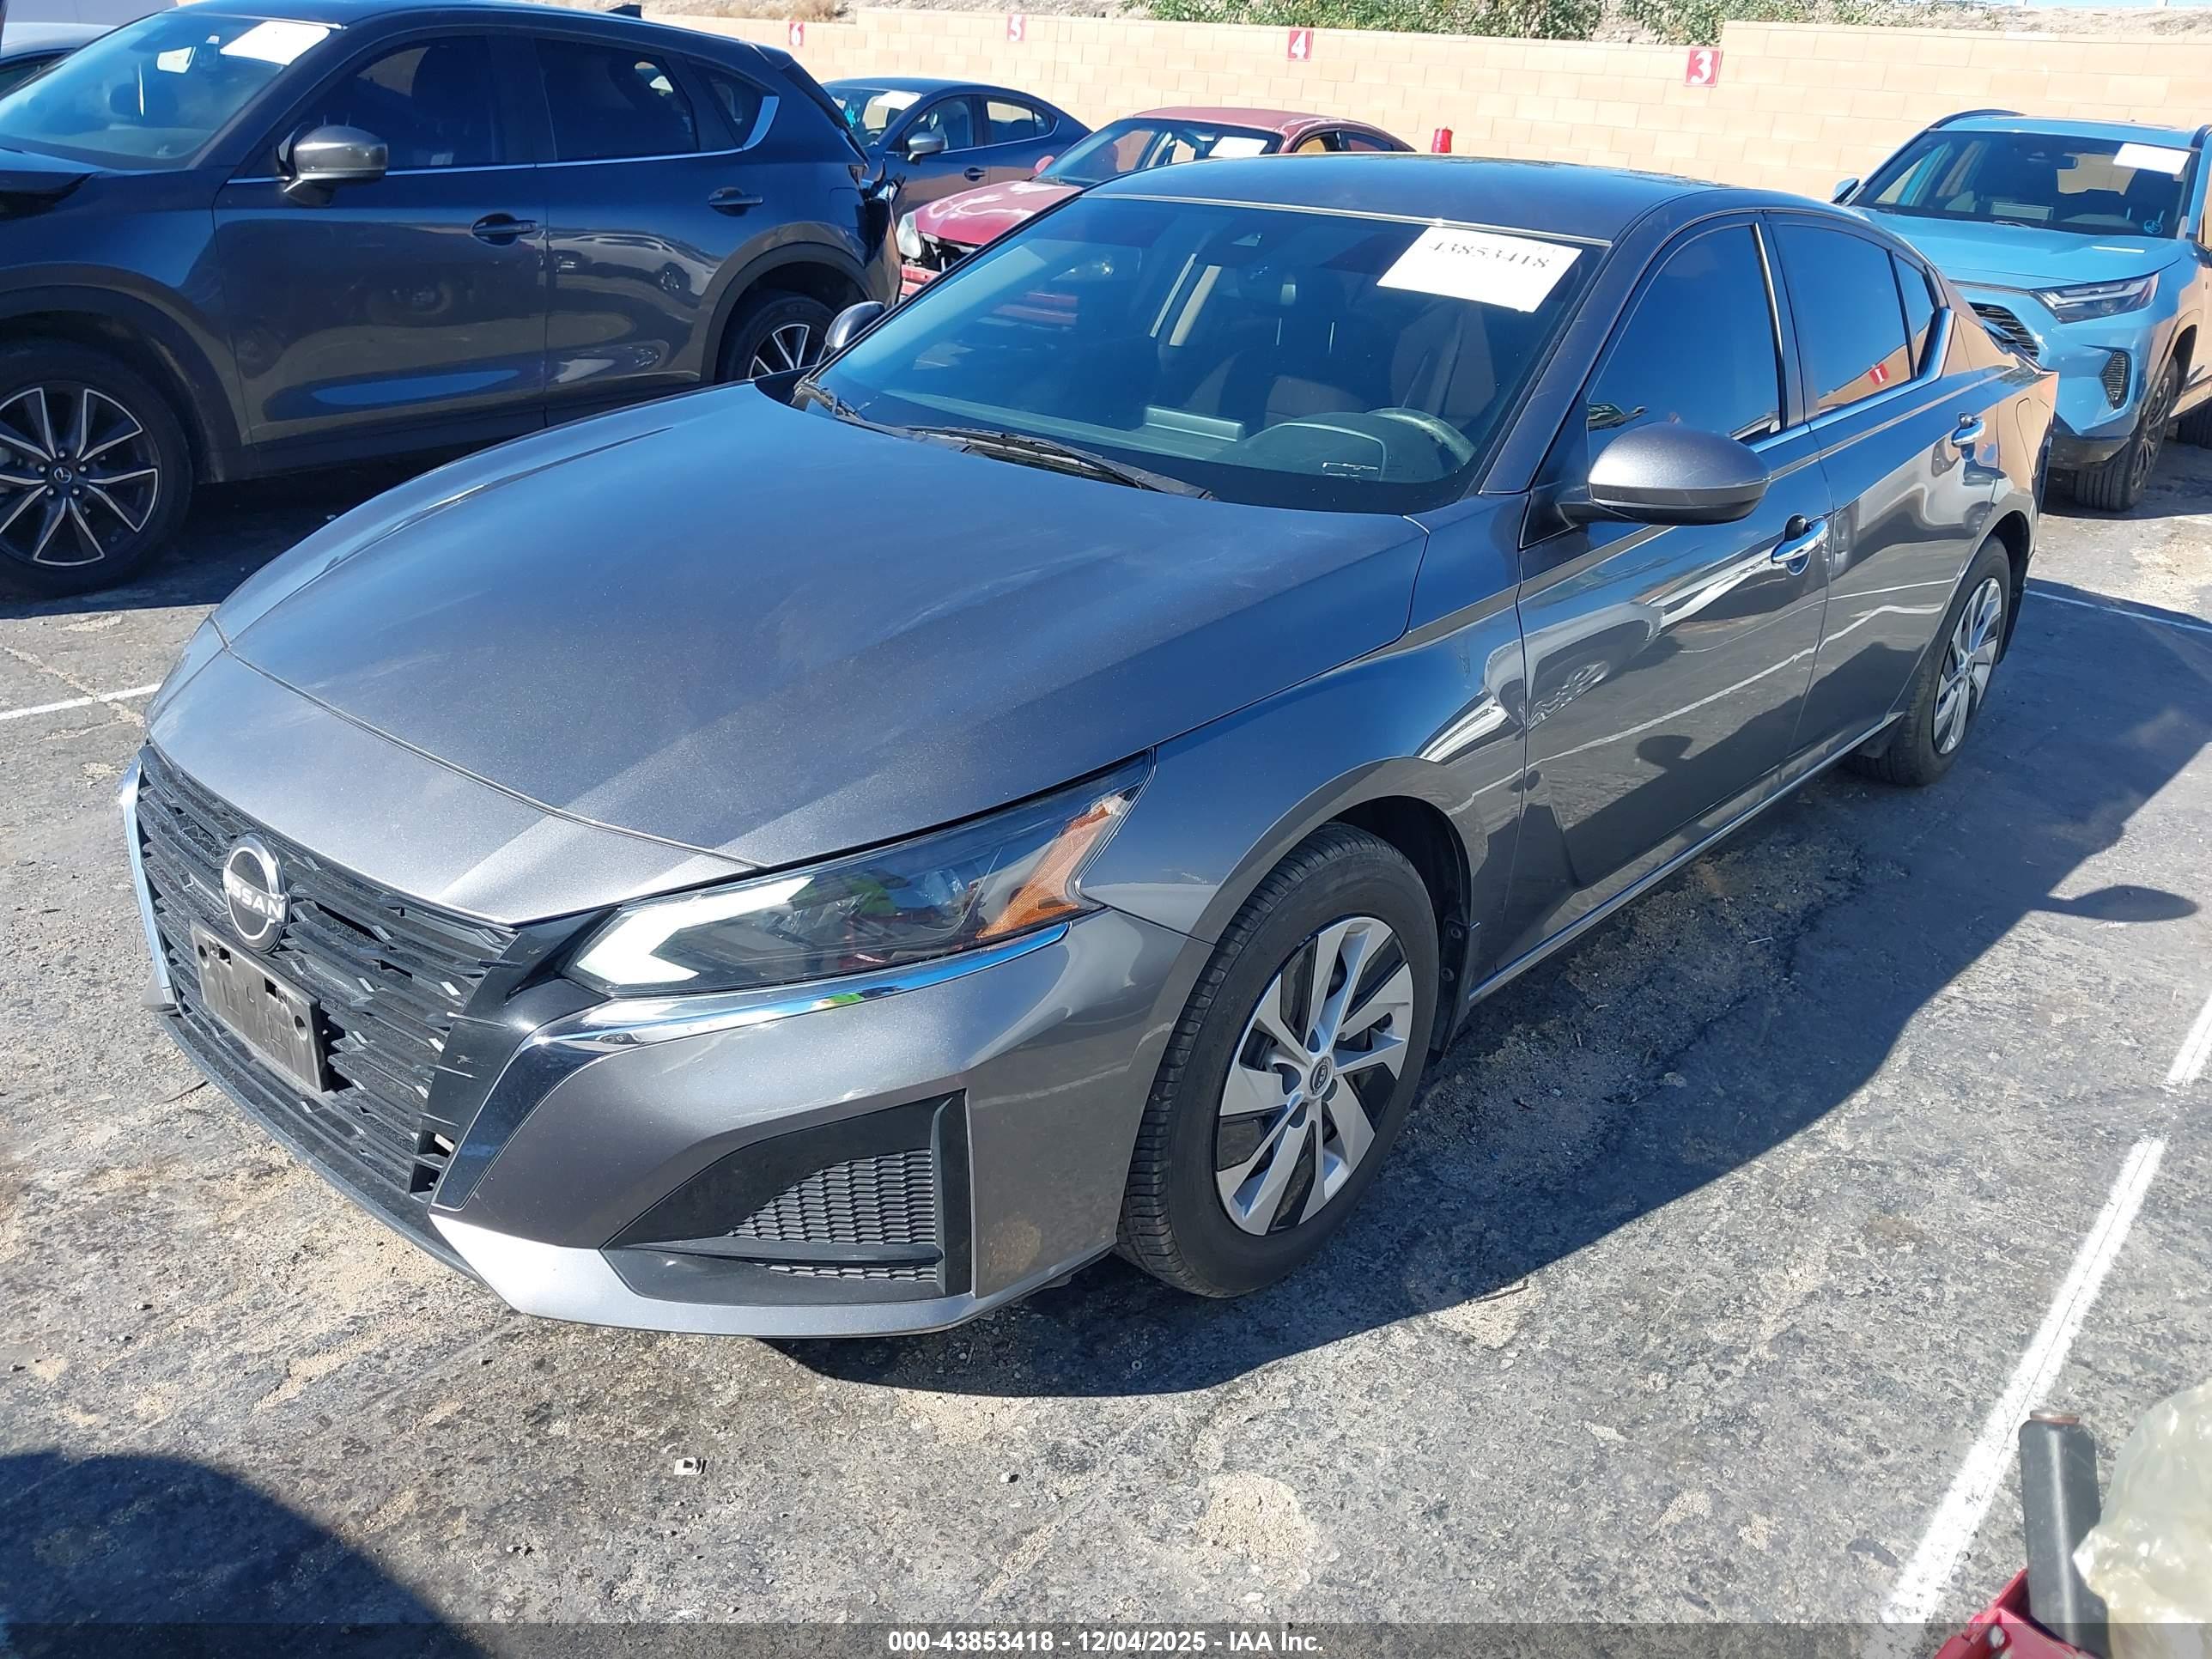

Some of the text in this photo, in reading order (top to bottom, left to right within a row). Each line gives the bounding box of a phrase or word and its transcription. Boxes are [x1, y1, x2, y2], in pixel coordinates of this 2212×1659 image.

[790, 22, 802, 46] 6
[1008, 15, 1022, 41] 5
[1291, 30, 1307, 59] 4
[1690, 50, 1713, 84] 3
[1428, 241, 1550, 268] 43853418
